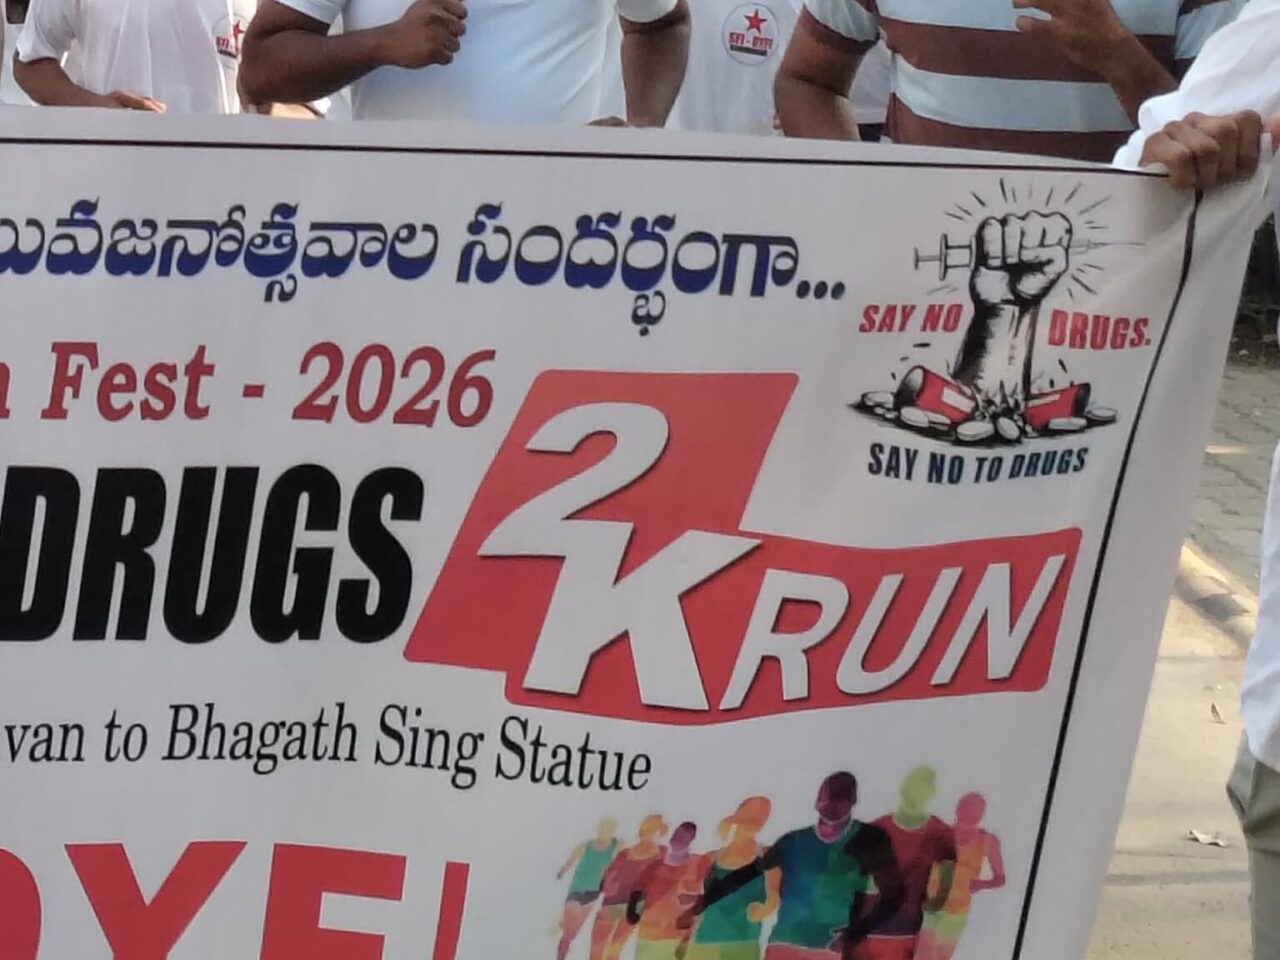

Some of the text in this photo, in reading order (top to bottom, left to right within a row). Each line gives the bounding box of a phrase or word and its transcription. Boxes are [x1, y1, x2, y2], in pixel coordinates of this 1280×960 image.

[859, 303, 917, 334] SAY
[920, 303, 964, 333] NO
[42, 340, 215, 420] Fest
[293, 340, 496, 429] 2026
[868, 443, 1090, 485] SAY NO TO DRUGS
[719, 554, 1068, 711] RUN
[104, 709, 149, 763] to
[161, 701, 359, 776] Bhagath
[373, 703, 486, 790] Sing
[494, 714, 653, 792] Statue
